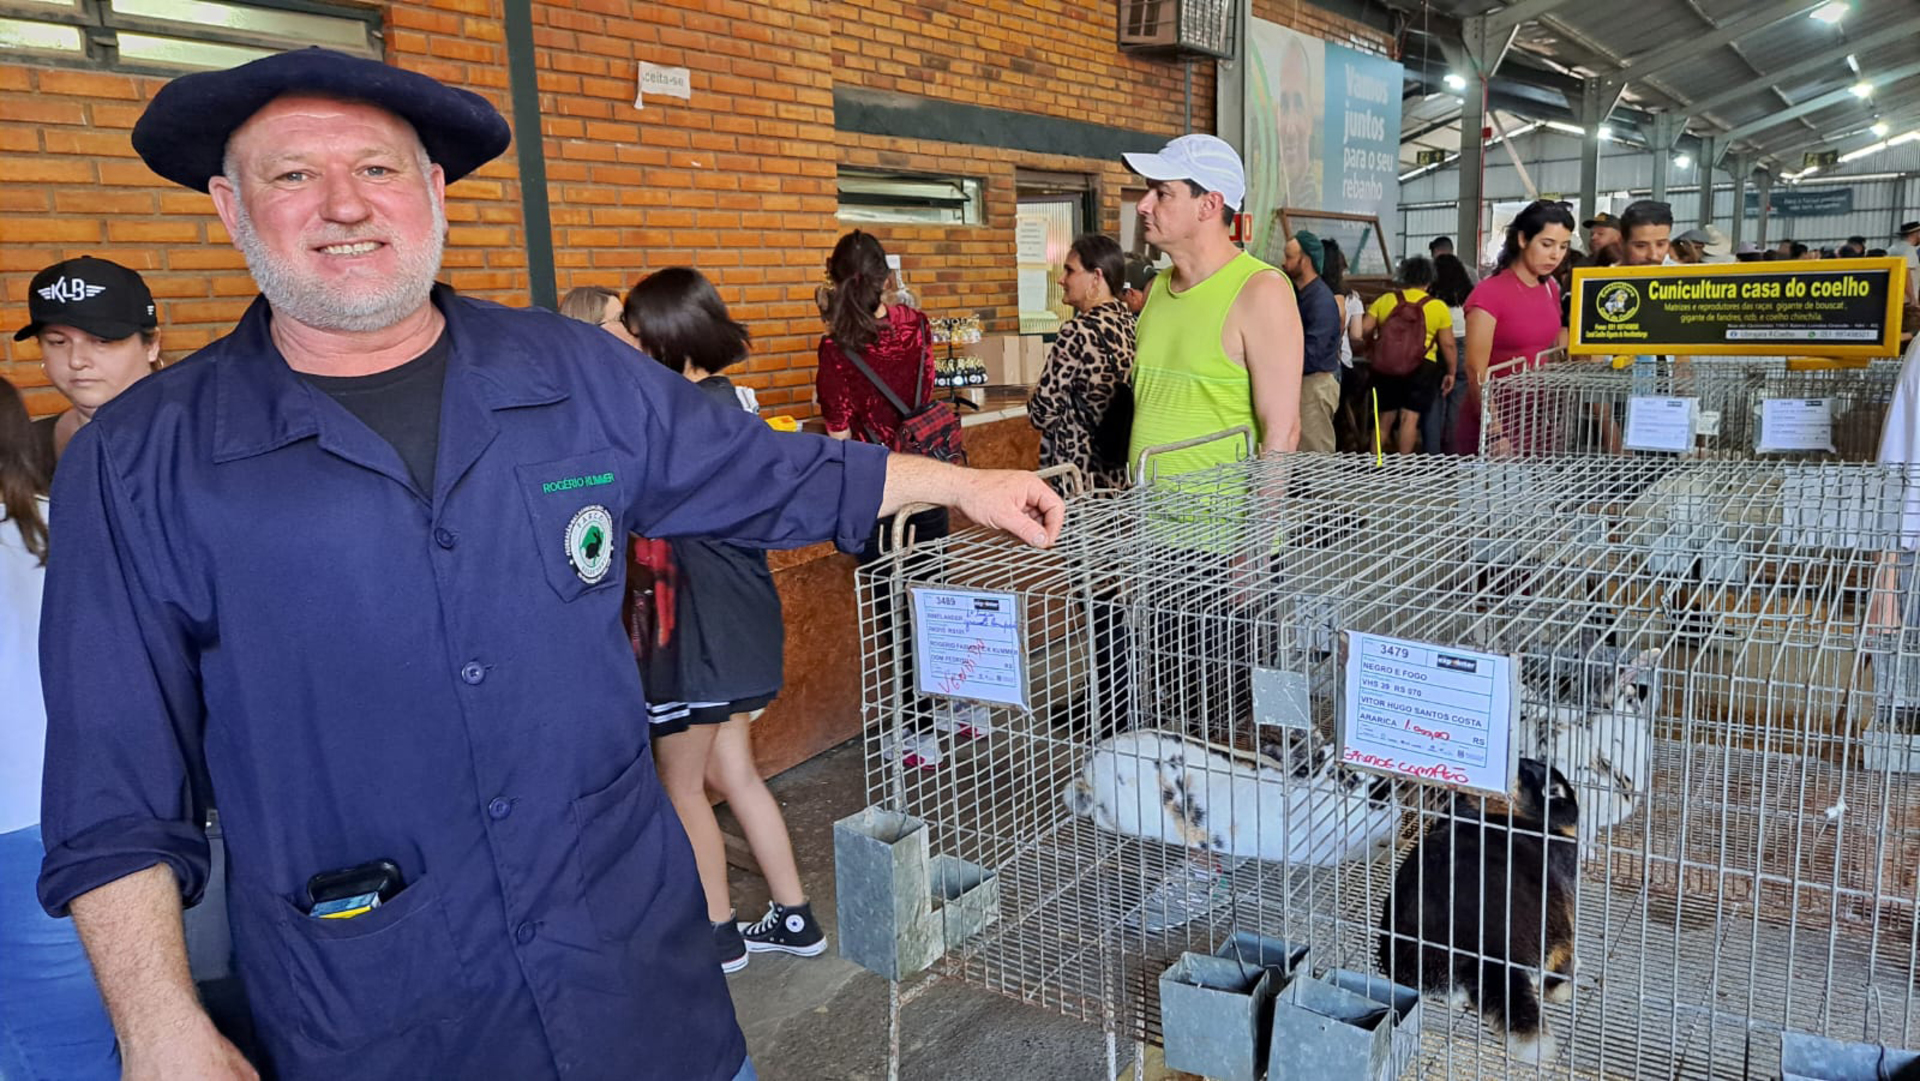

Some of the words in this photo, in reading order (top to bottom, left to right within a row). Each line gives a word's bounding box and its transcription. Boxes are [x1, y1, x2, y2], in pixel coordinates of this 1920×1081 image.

[1345, 63, 1388, 105] Vamos
[1344, 102, 1385, 144] juntos
[1343, 147, 1366, 173] para
[1368, 151, 1375, 168] o
[1377, 153, 1393, 173] seu
[1342, 172, 1383, 201] rebanho
[50, 276, 86, 304] KLB
[1648, 280, 1738, 300] Cunicultura
[1741, 281, 1781, 299] casa
[1785, 277, 1806, 298] do
[1810, 276, 1870, 297] coelho
[1379, 643, 1409, 659] 3479
[1361, 678, 1378, 689] VHS
[1363, 662, 1393, 675] NEGRO
[1402, 670, 1428, 681] FOGO
[1361, 695, 1386, 708] VITOR
[1387, 701, 1412, 713] HUGO
[1414, 707, 1450, 722] SANTOS
[1451, 715, 1482, 728] COSTA
[1472, 736, 1485, 746] RS
